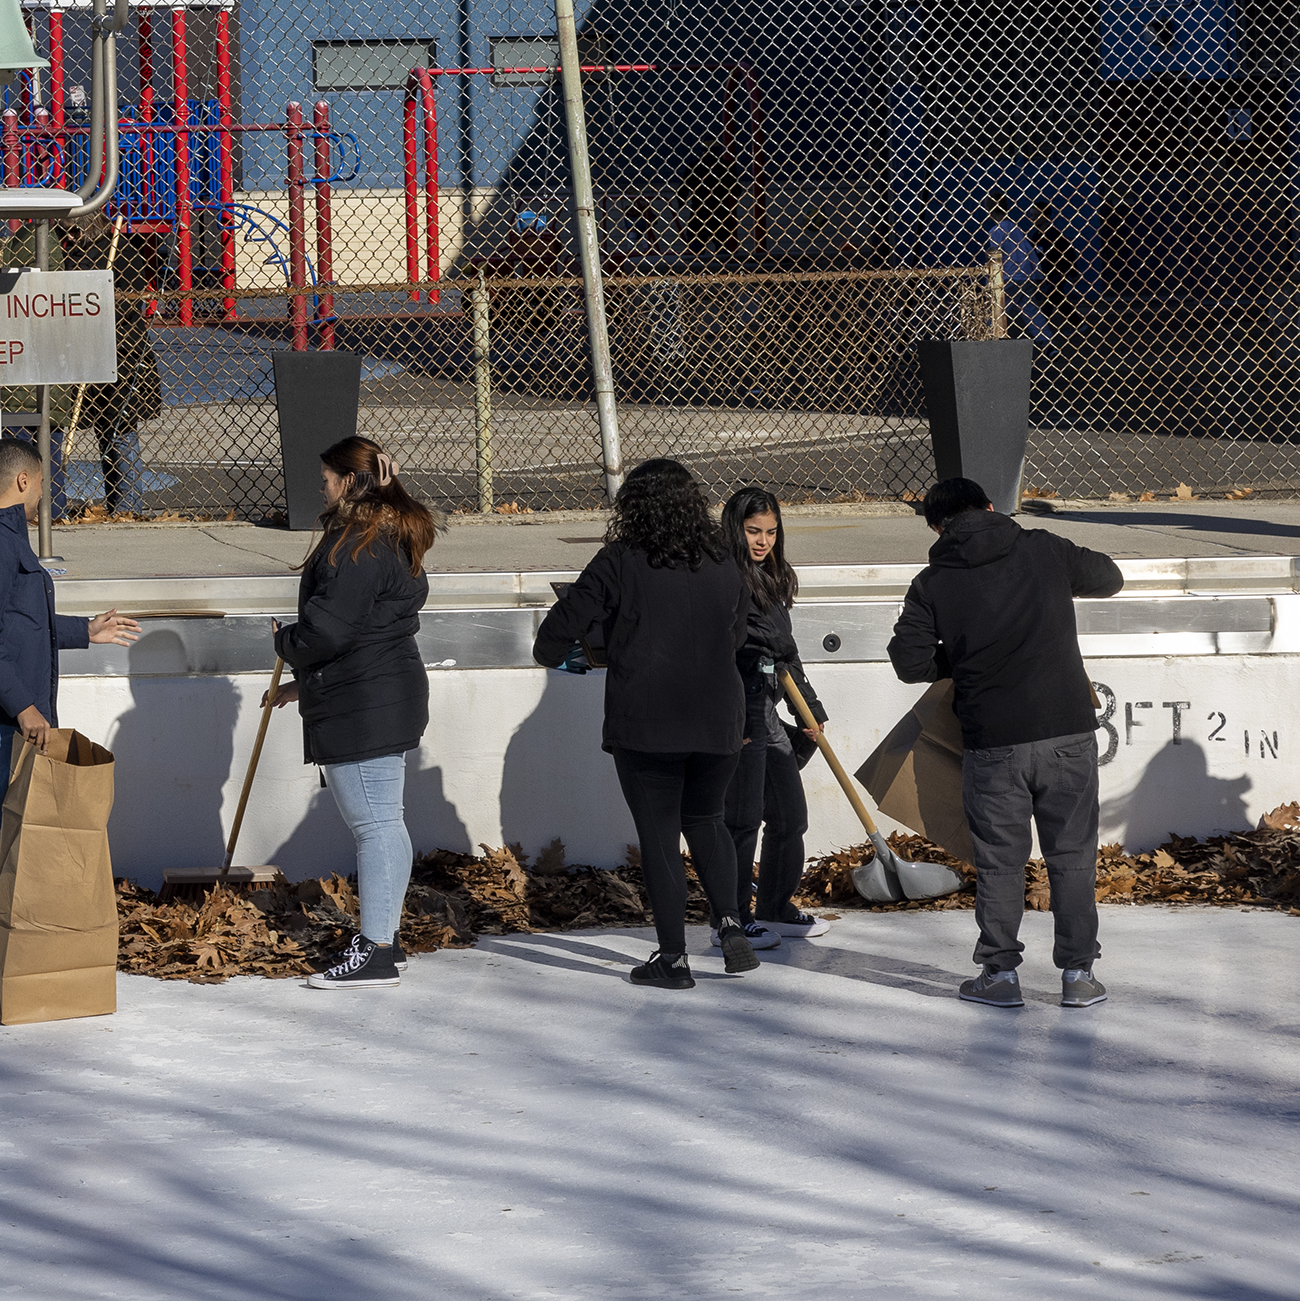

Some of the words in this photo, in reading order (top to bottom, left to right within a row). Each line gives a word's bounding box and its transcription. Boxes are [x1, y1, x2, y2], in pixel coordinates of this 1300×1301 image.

[7, 292, 101, 319] INCHES
[1207, 712, 1227, 742] 2
[1244, 729, 1279, 759] IN
